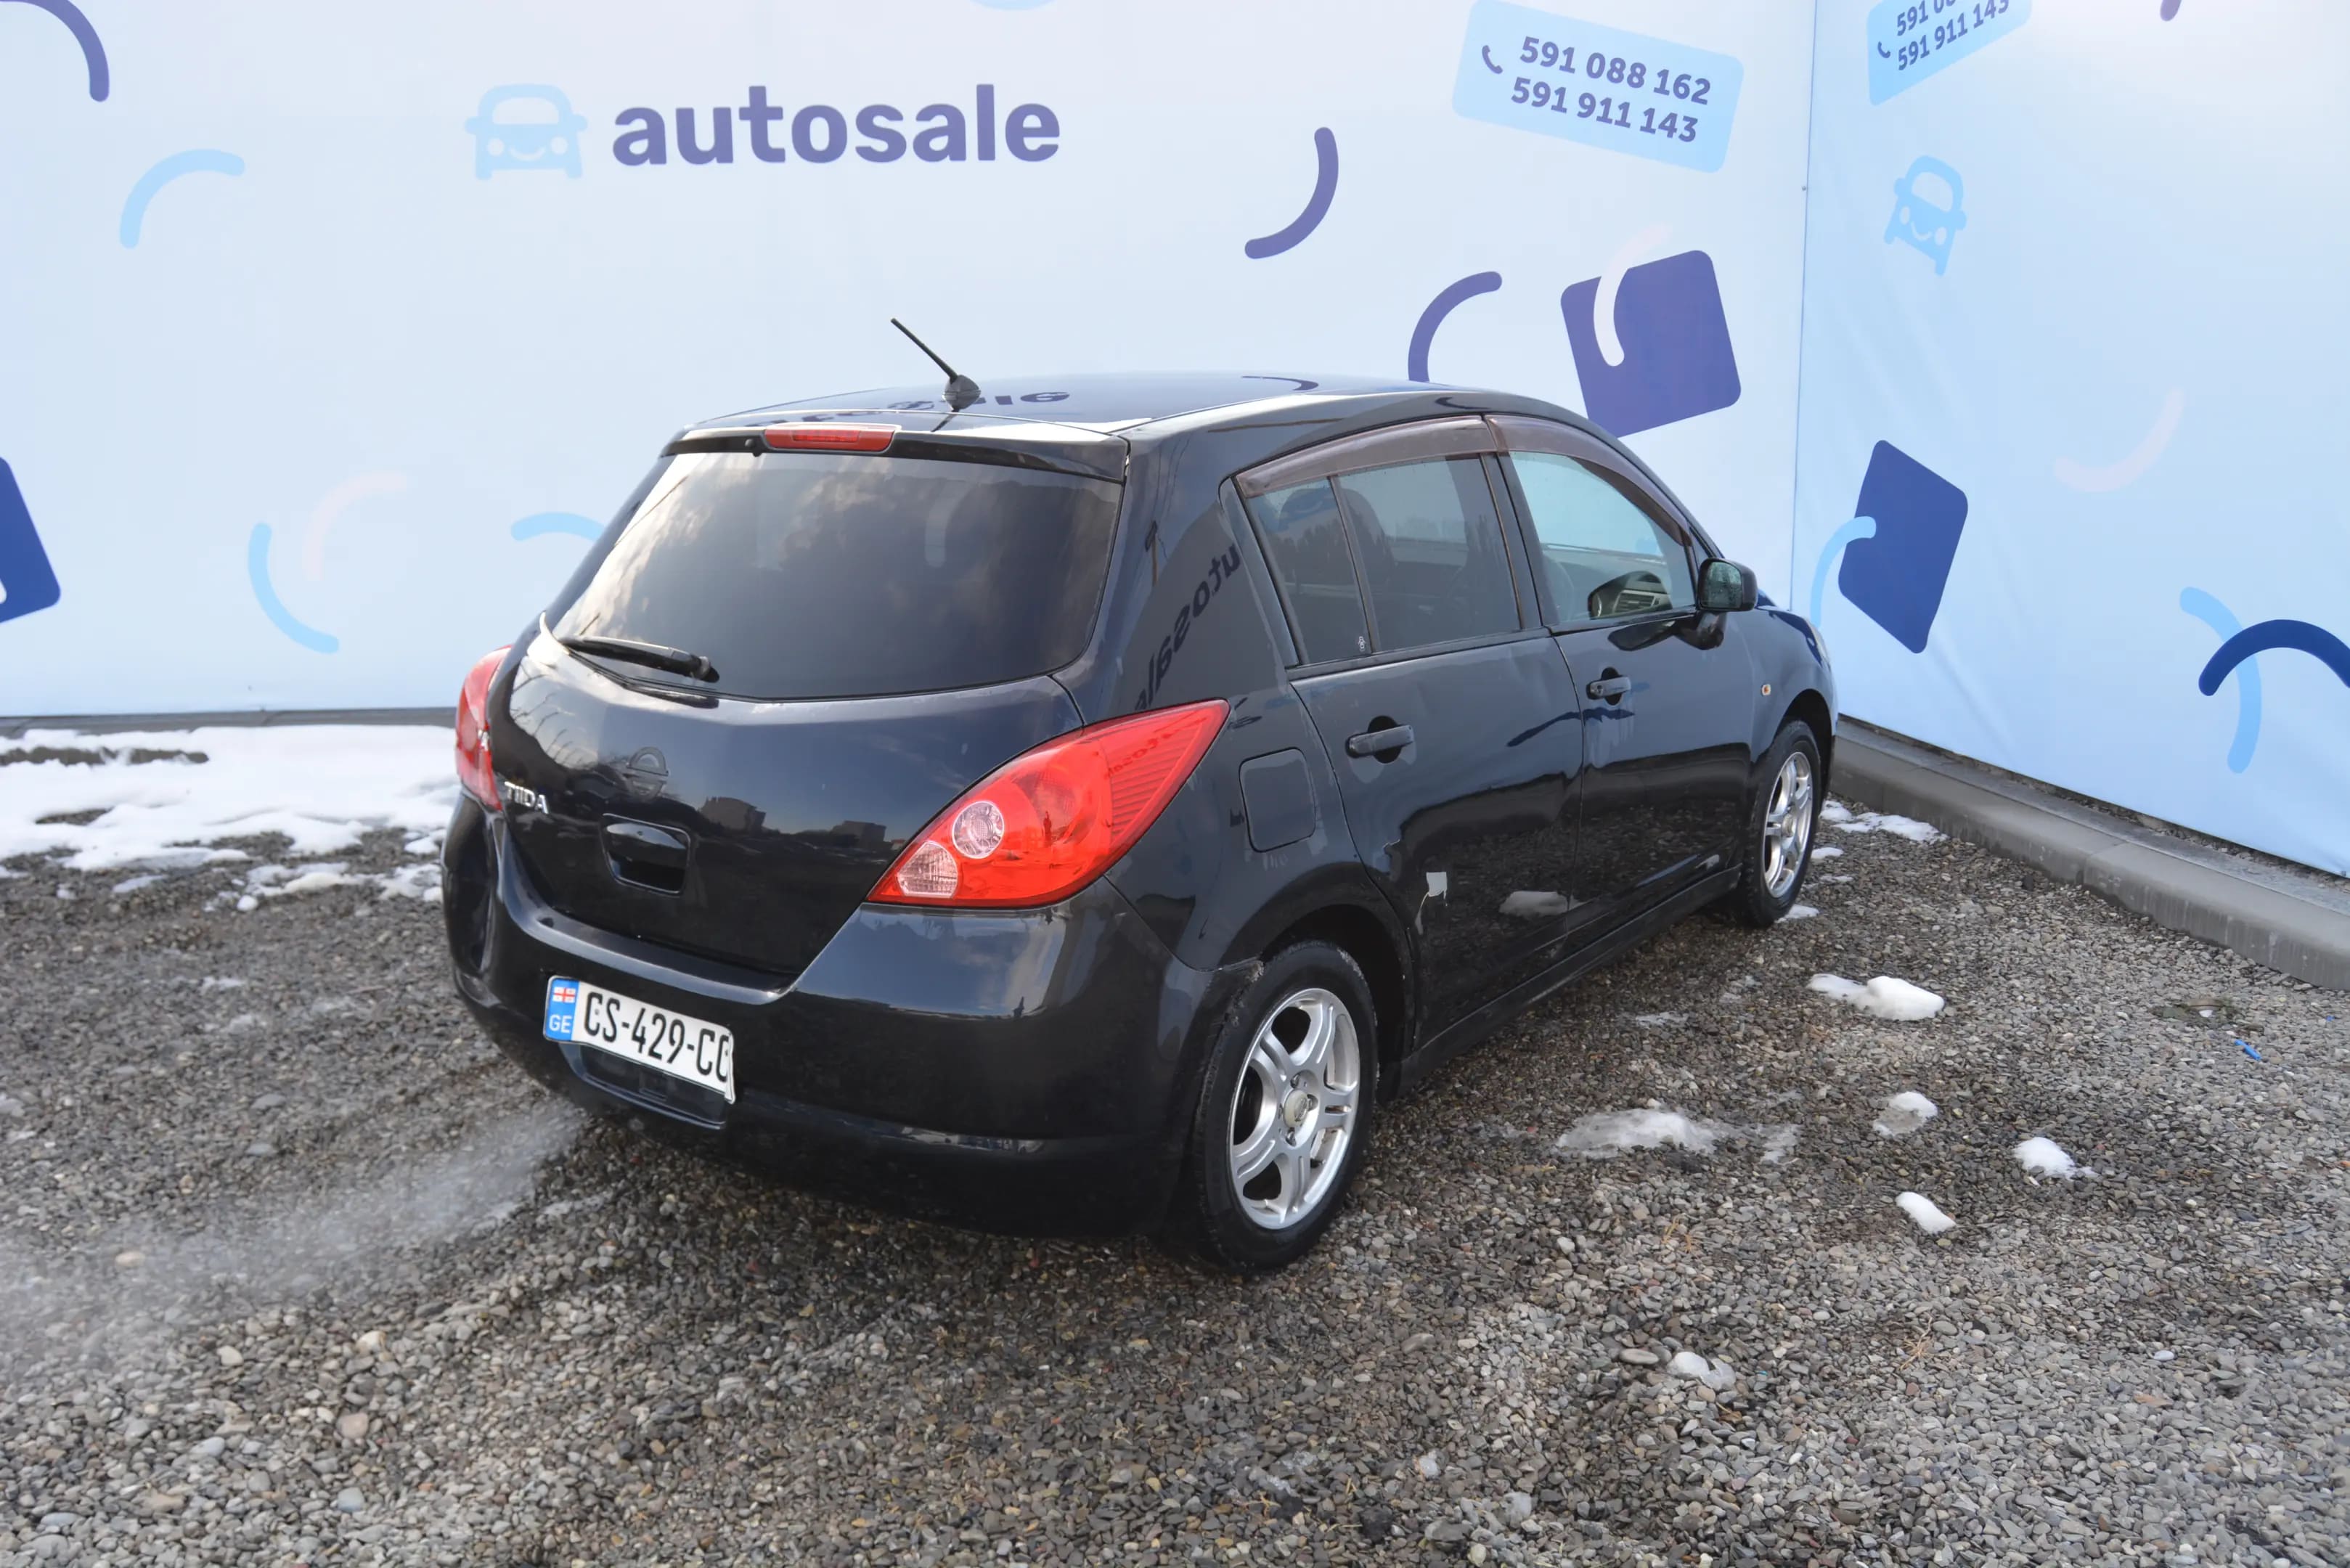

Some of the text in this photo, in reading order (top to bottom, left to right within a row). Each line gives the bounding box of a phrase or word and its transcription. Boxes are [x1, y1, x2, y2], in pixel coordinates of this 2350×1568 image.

[1897, 0, 1928, 36] 591
[1898, 35, 1930, 70] 591
[1934, 12, 1967, 50] 911
[1520, 36, 1710, 105] 591 088 162
[612, 83, 1060, 166] autosale
[1511, 76, 1699, 142] 591 911 143
[504, 780, 549, 814] TIIDA
[549, 1014, 574, 1034] GE
